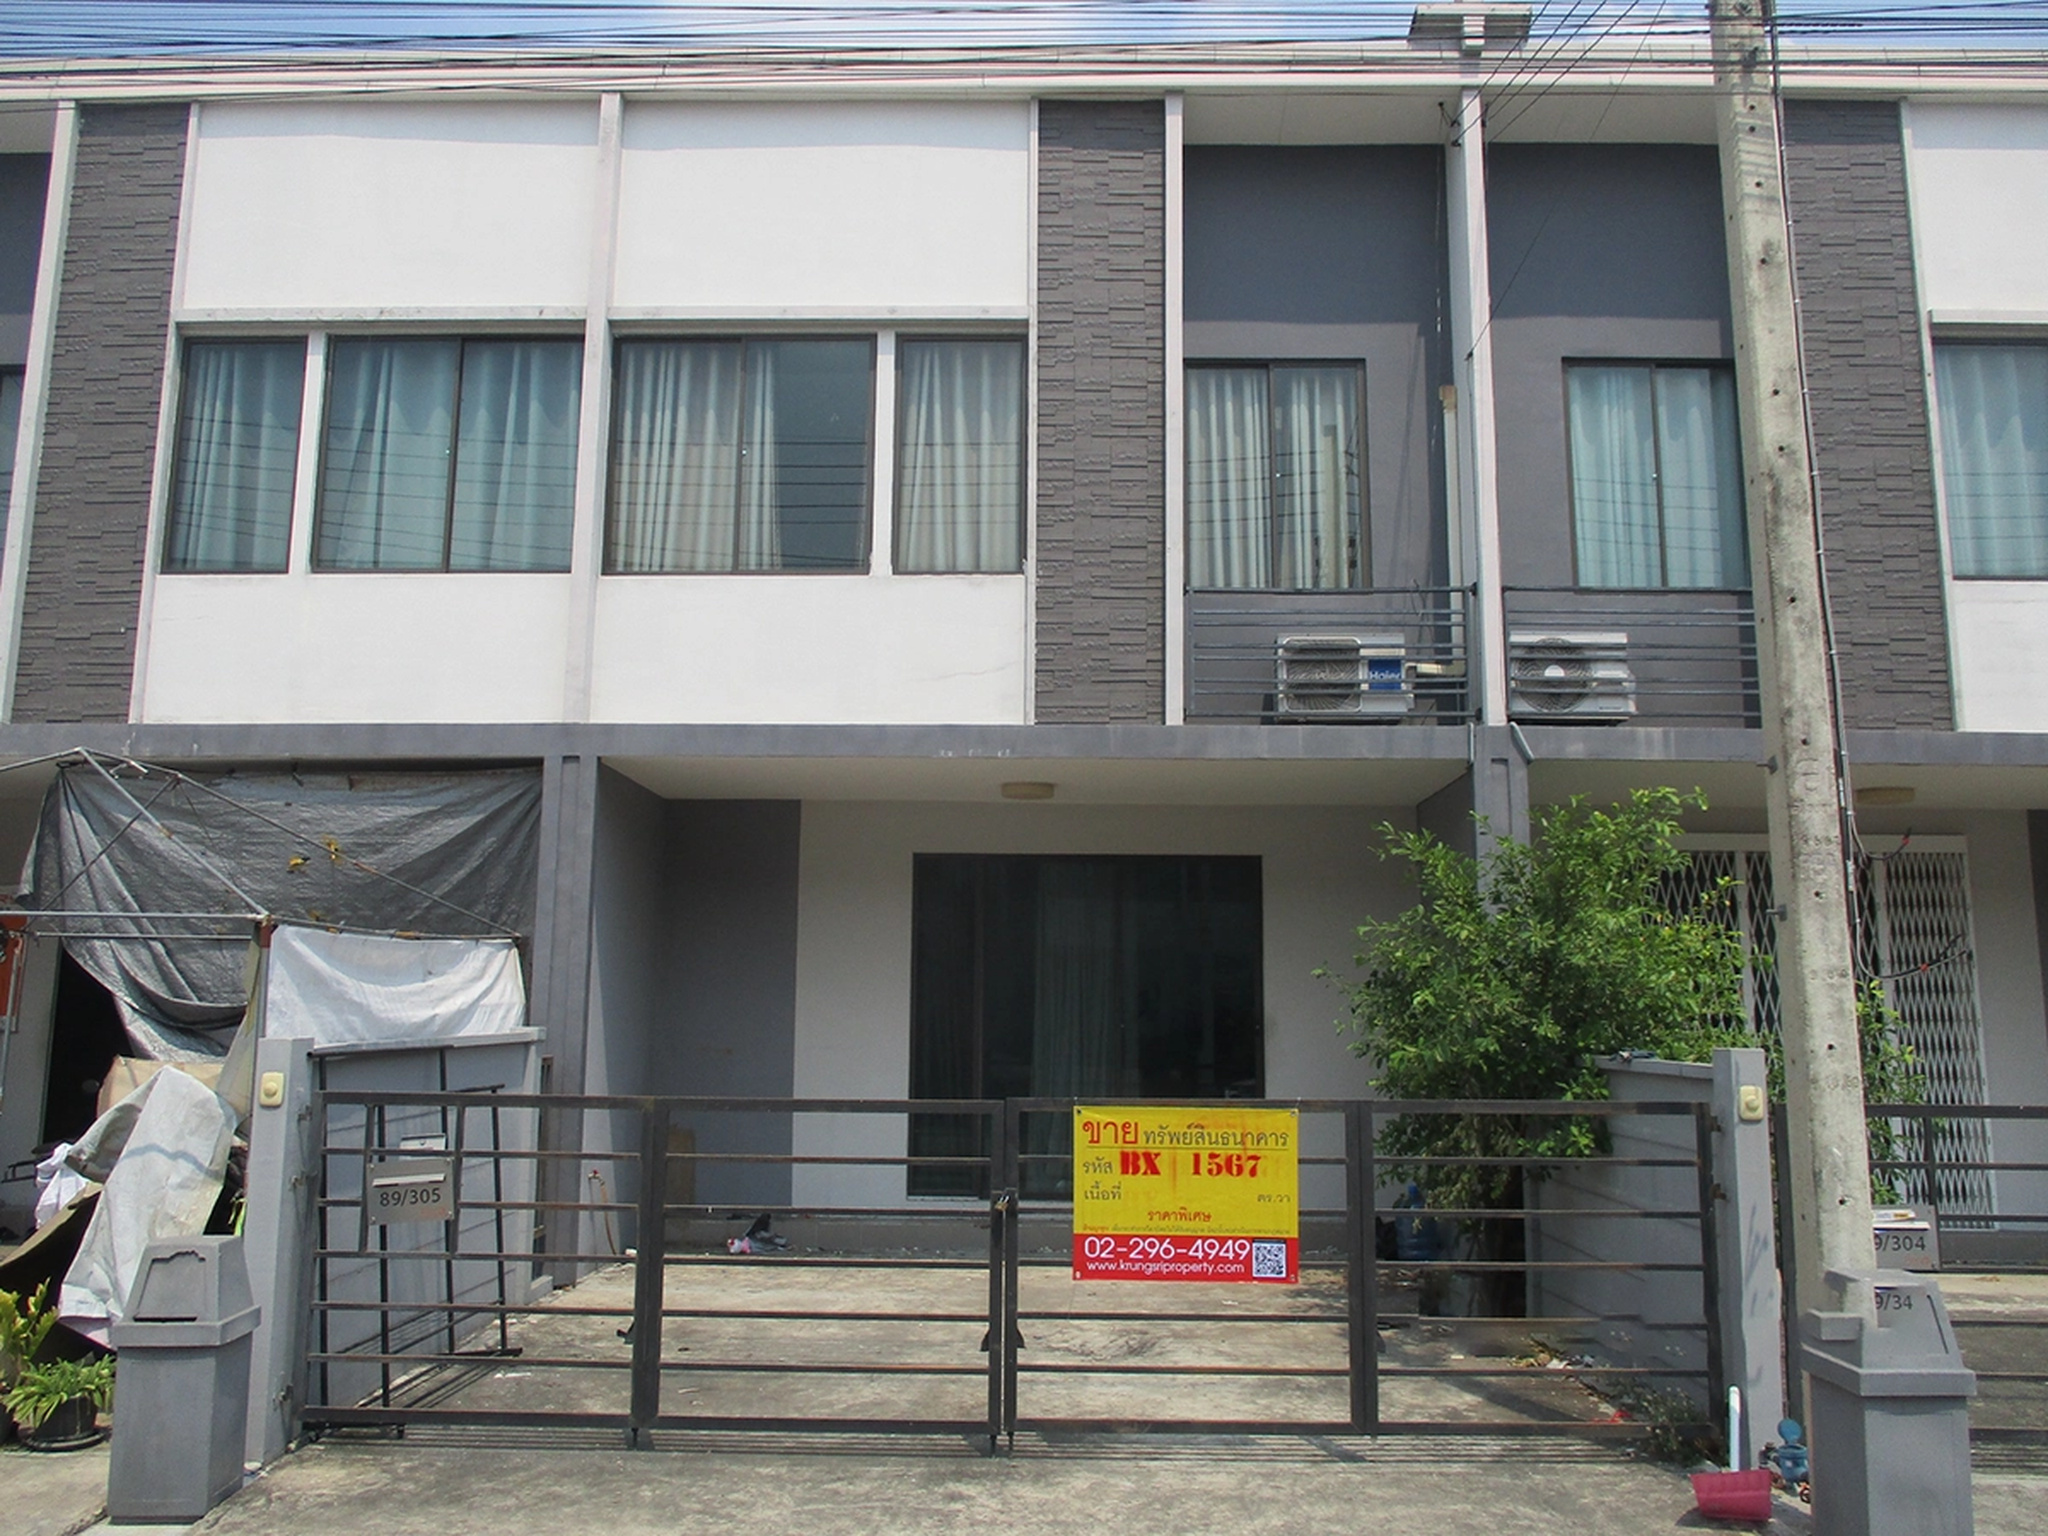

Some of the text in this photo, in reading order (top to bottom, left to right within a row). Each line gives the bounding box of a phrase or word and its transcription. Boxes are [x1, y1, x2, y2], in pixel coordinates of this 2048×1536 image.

[1082, 1120, 1289, 1147] ขาย ทรัพย์สินธนาคาร
[1083, 1151, 1261, 1178] รหัส BX 1567
[380, 1188, 441, 1207] 89/305
[1084, 1181, 1122, 1200] เนื้อที่
[1147, 1206, 1212, 1222] ราคาพิเศษ
[1084, 1236, 1250, 1260] 02-296-4949
[1086, 1260, 1245, 1275] www.krungsriproperty.com
